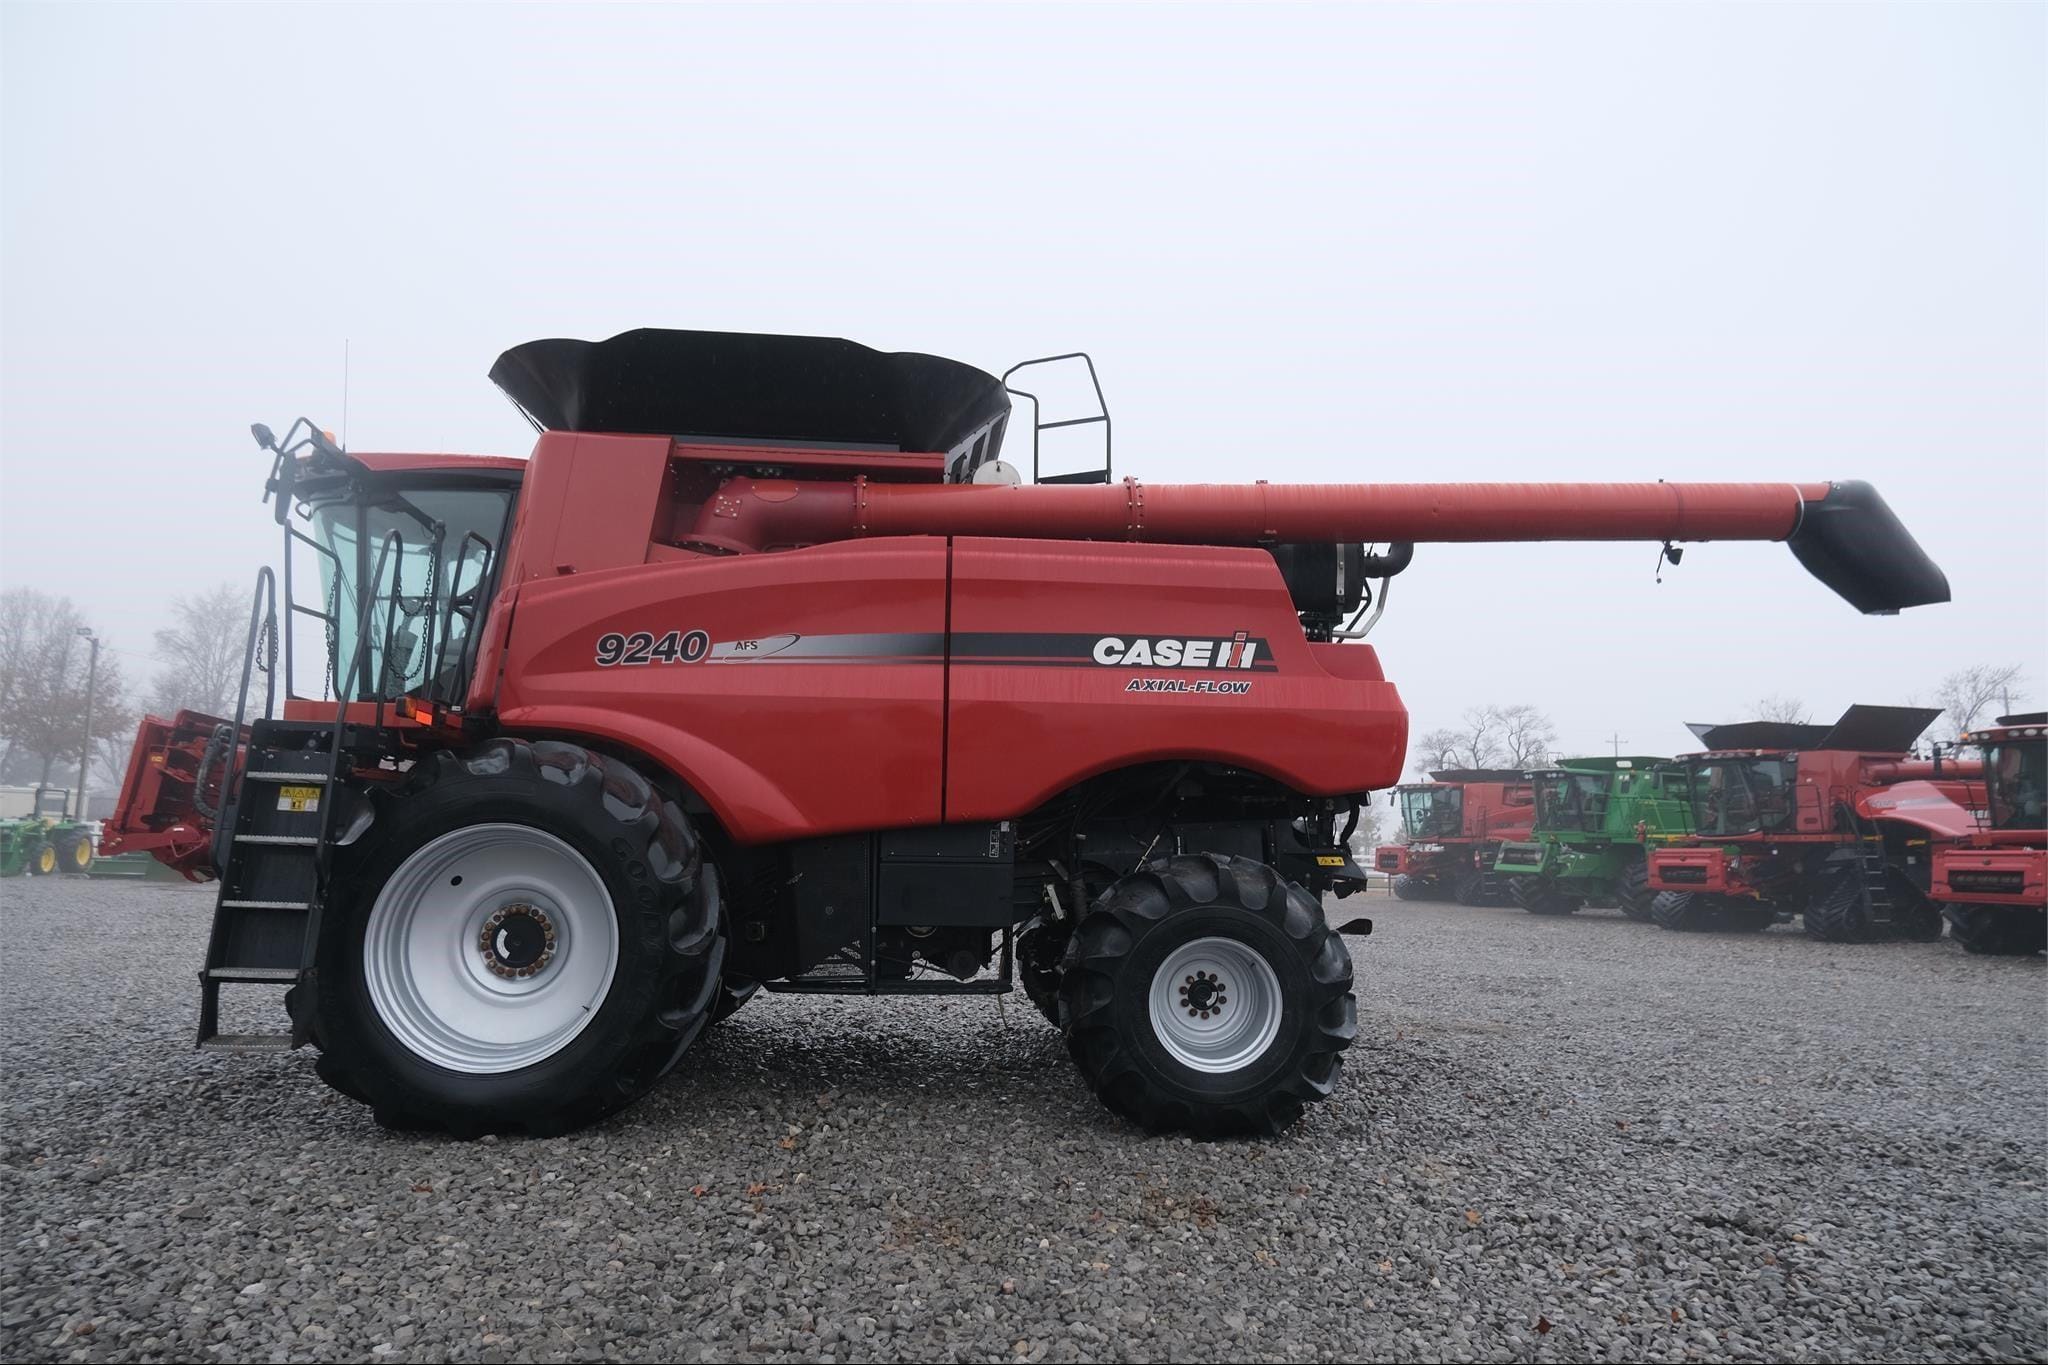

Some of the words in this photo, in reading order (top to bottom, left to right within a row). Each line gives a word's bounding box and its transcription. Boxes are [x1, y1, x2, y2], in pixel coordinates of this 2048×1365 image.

[595, 630, 710, 667] 9240
[735, 640, 758, 650] AFS
[1093, 637, 1213, 667] CASE
[1125, 678, 1252, 694] AXIAL-FLOW
